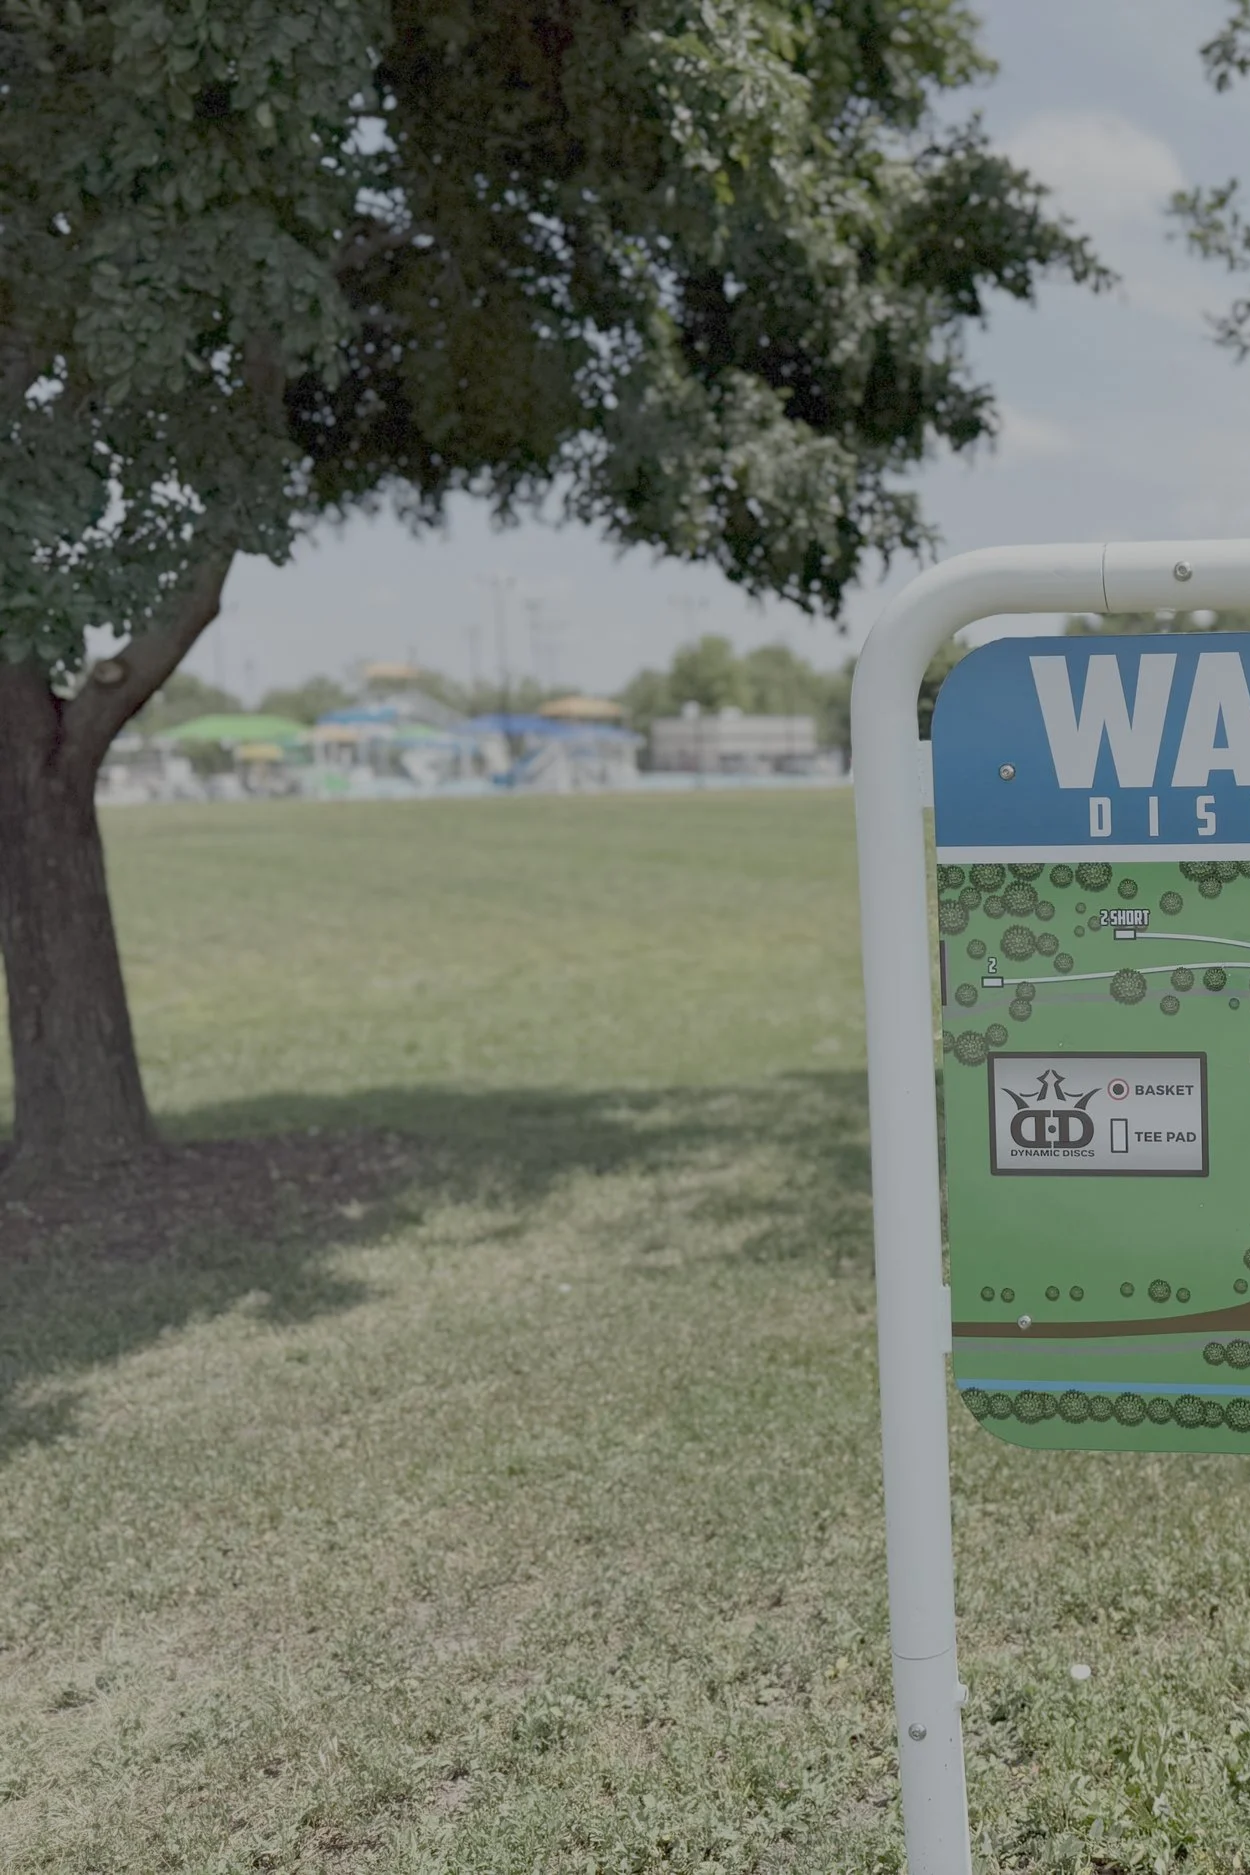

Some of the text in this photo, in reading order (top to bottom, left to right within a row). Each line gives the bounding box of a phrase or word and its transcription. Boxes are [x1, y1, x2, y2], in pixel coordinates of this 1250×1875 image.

[1100, 908, 1151, 927] 2 SHORT
[987, 957, 997, 974] 2
[1134, 1083, 1195, 1097] BASKET
[1134, 1130, 1197, 1144] TEE PAD
[1010, 1148, 1095, 1157] DYNAMIC DISCS
